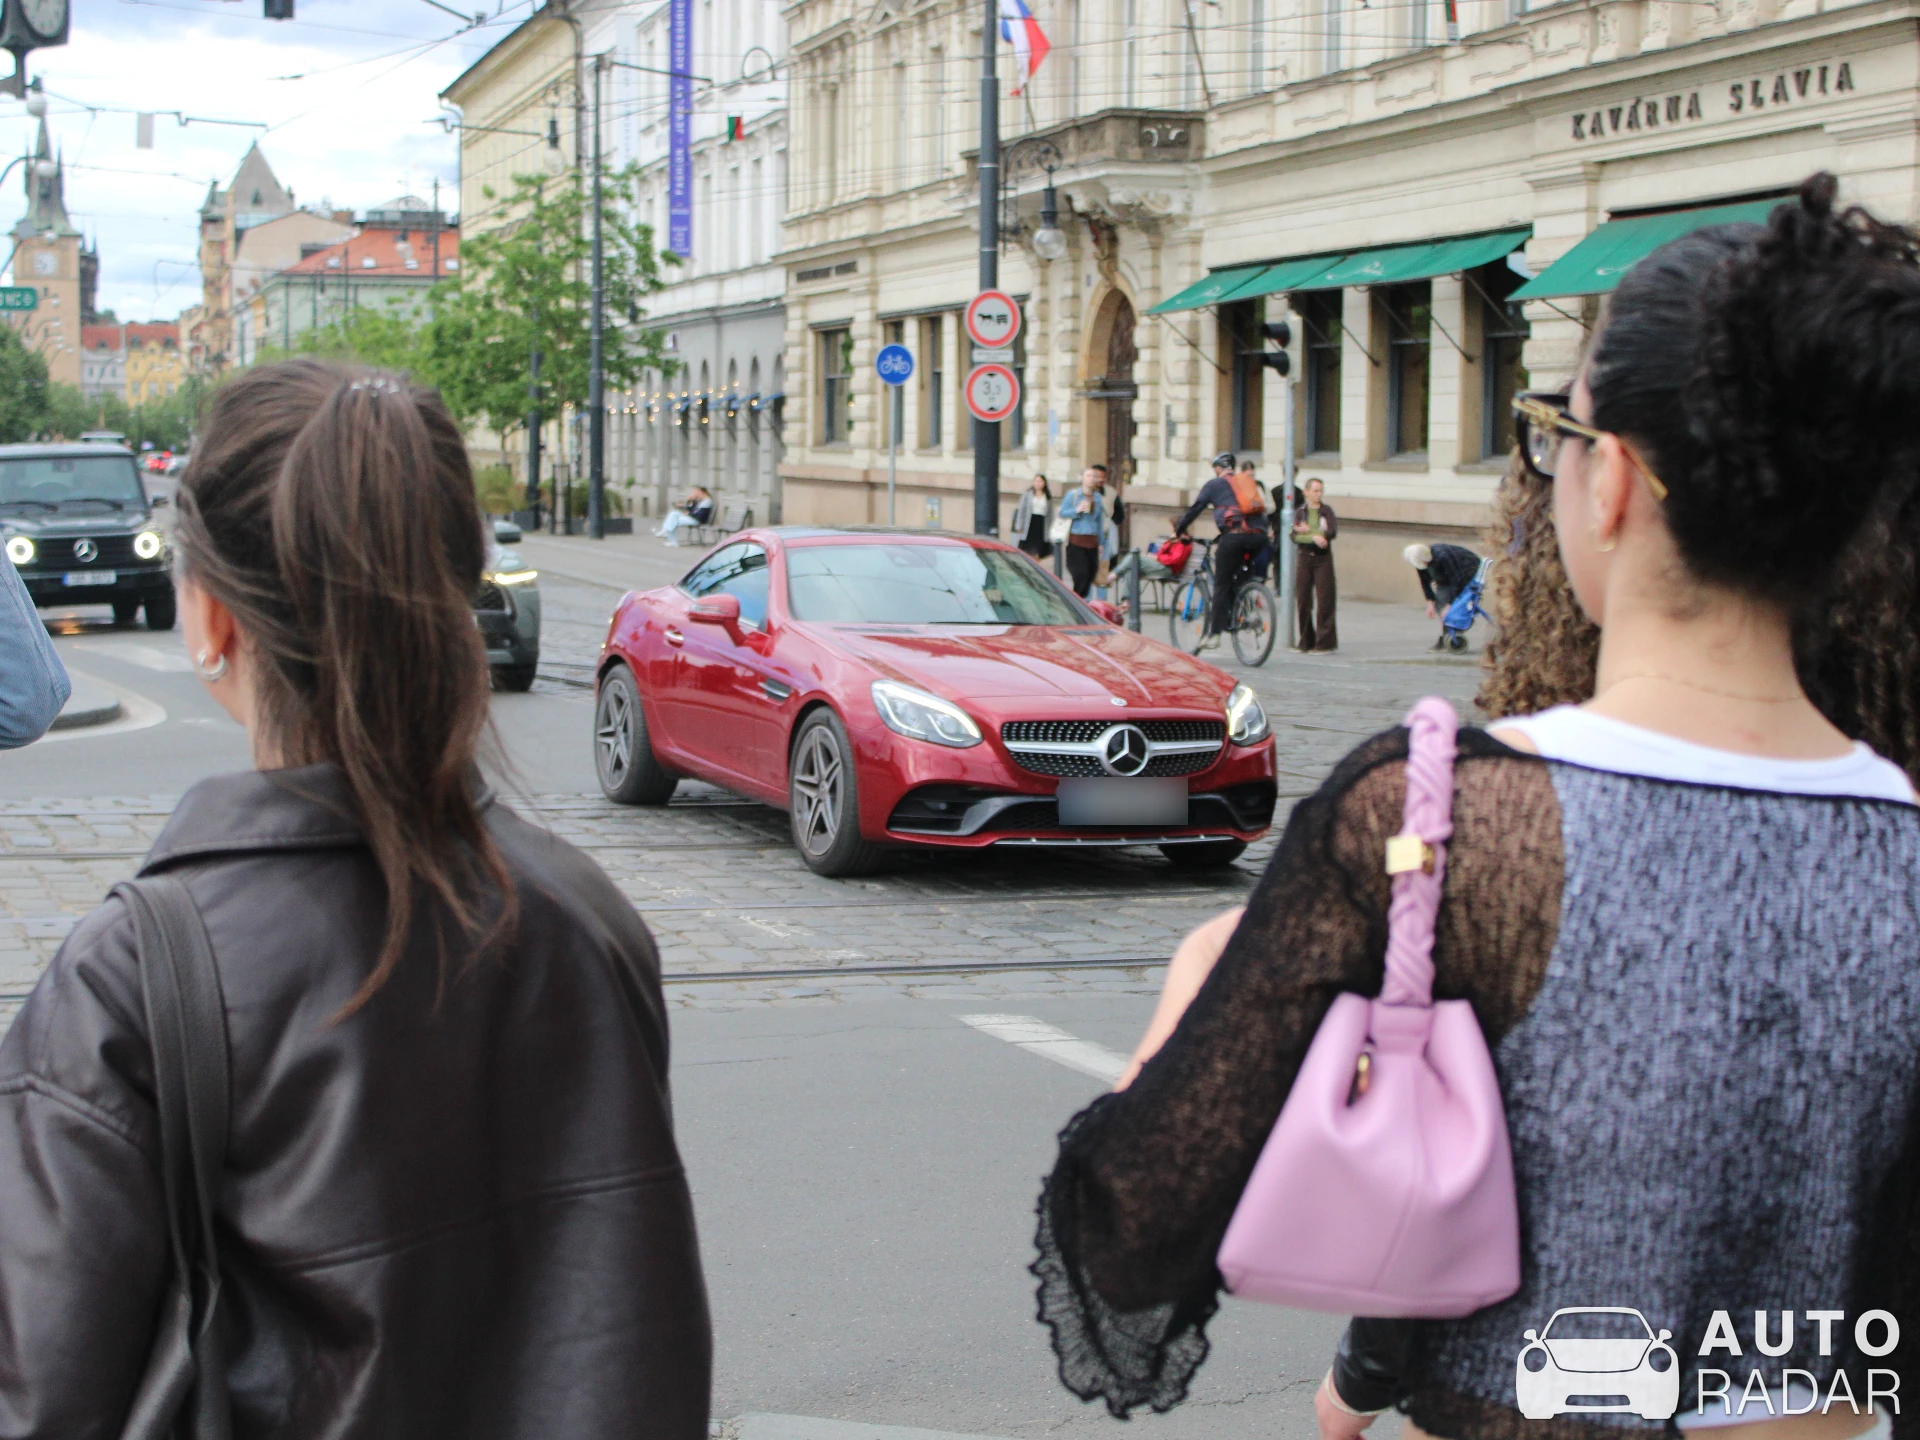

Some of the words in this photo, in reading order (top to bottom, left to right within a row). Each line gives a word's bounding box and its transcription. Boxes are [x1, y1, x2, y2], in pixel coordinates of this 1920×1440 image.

[675, 0, 686, 70] ACCESSORIE
[1572, 92, 1701, 139] KAVÁRNA
[1729, 62, 1853, 111] SLAVIA
